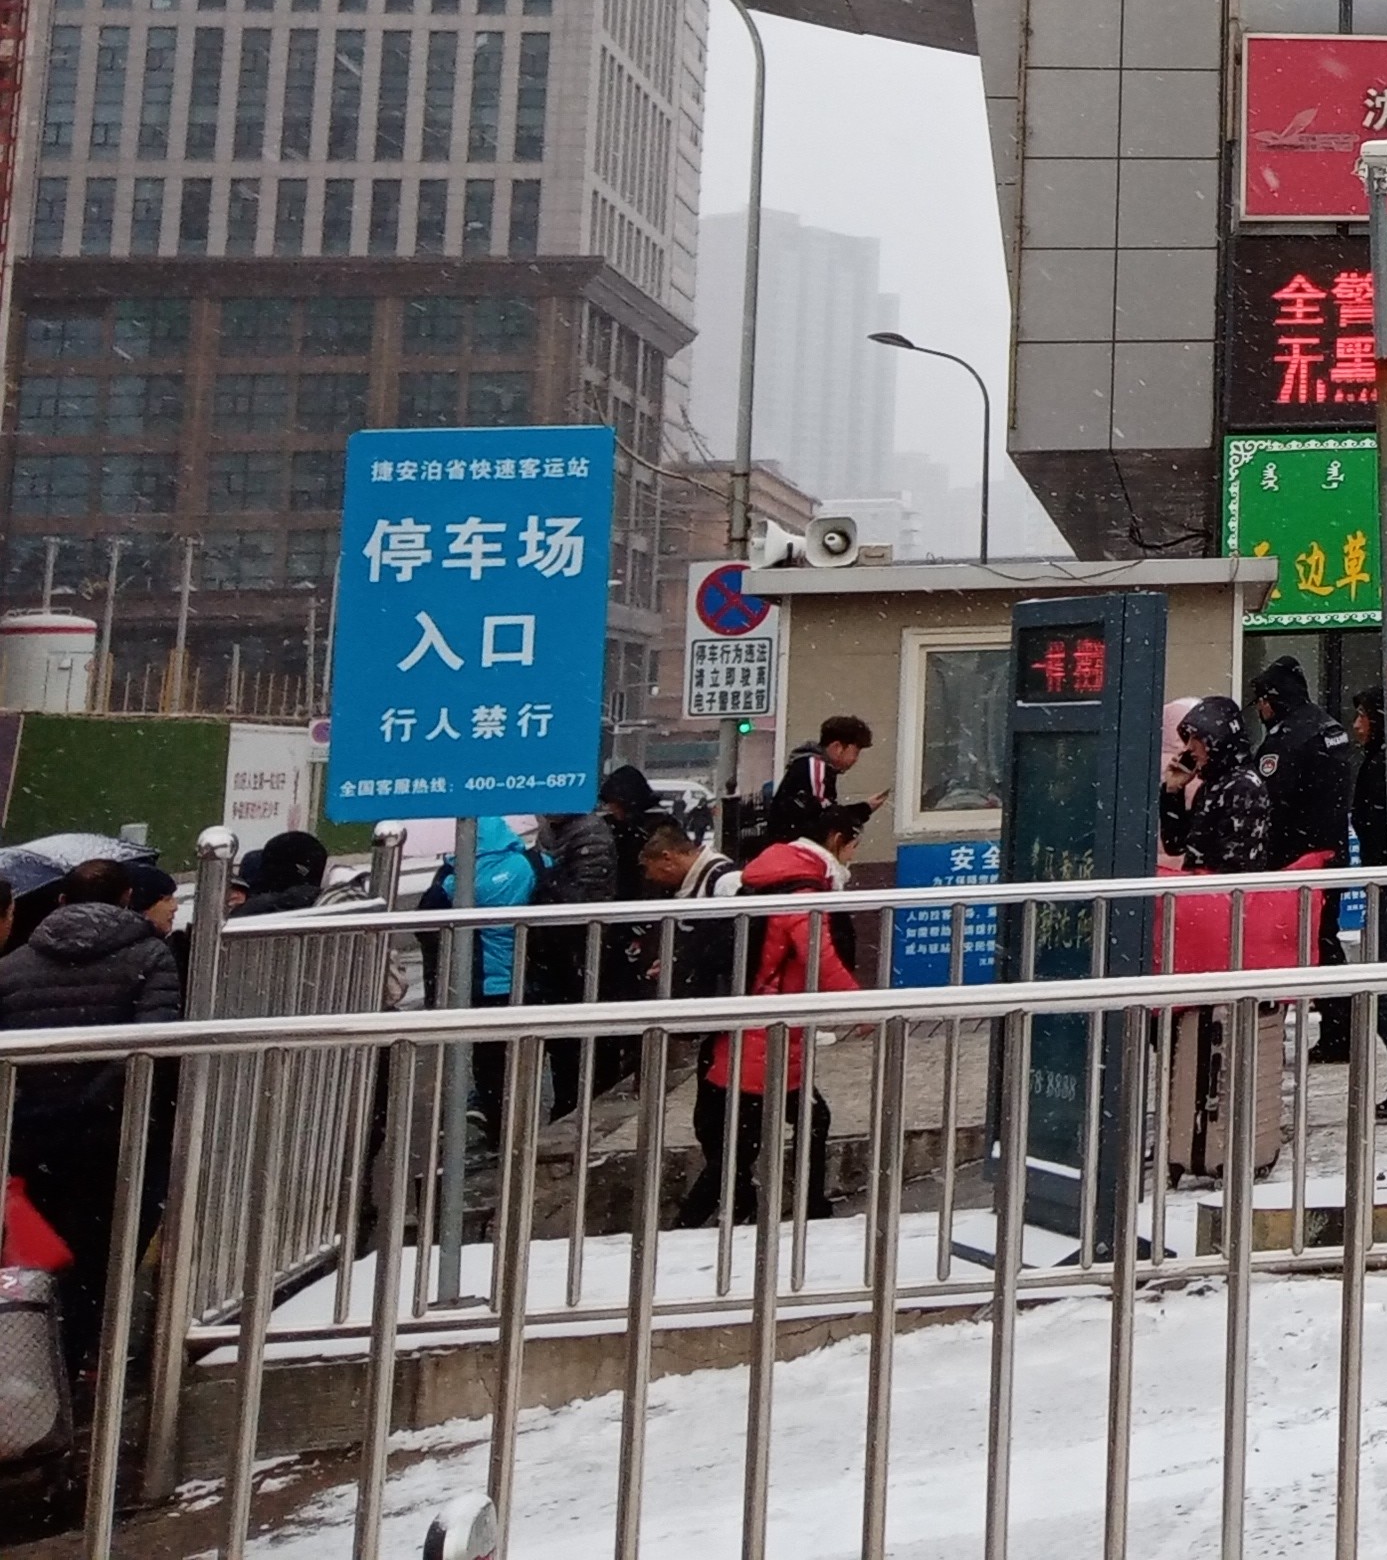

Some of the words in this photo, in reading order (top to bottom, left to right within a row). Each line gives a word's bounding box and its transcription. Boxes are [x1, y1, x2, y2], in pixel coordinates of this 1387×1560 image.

[371, 457, 590, 483] 捷安泊省快速客运站
[362, 515, 585, 583] 停车场
[397, 610, 536, 672] 入口
[380, 703, 554, 743] 行人禁行
[464, 772, 587, 791] 400-024-6877
